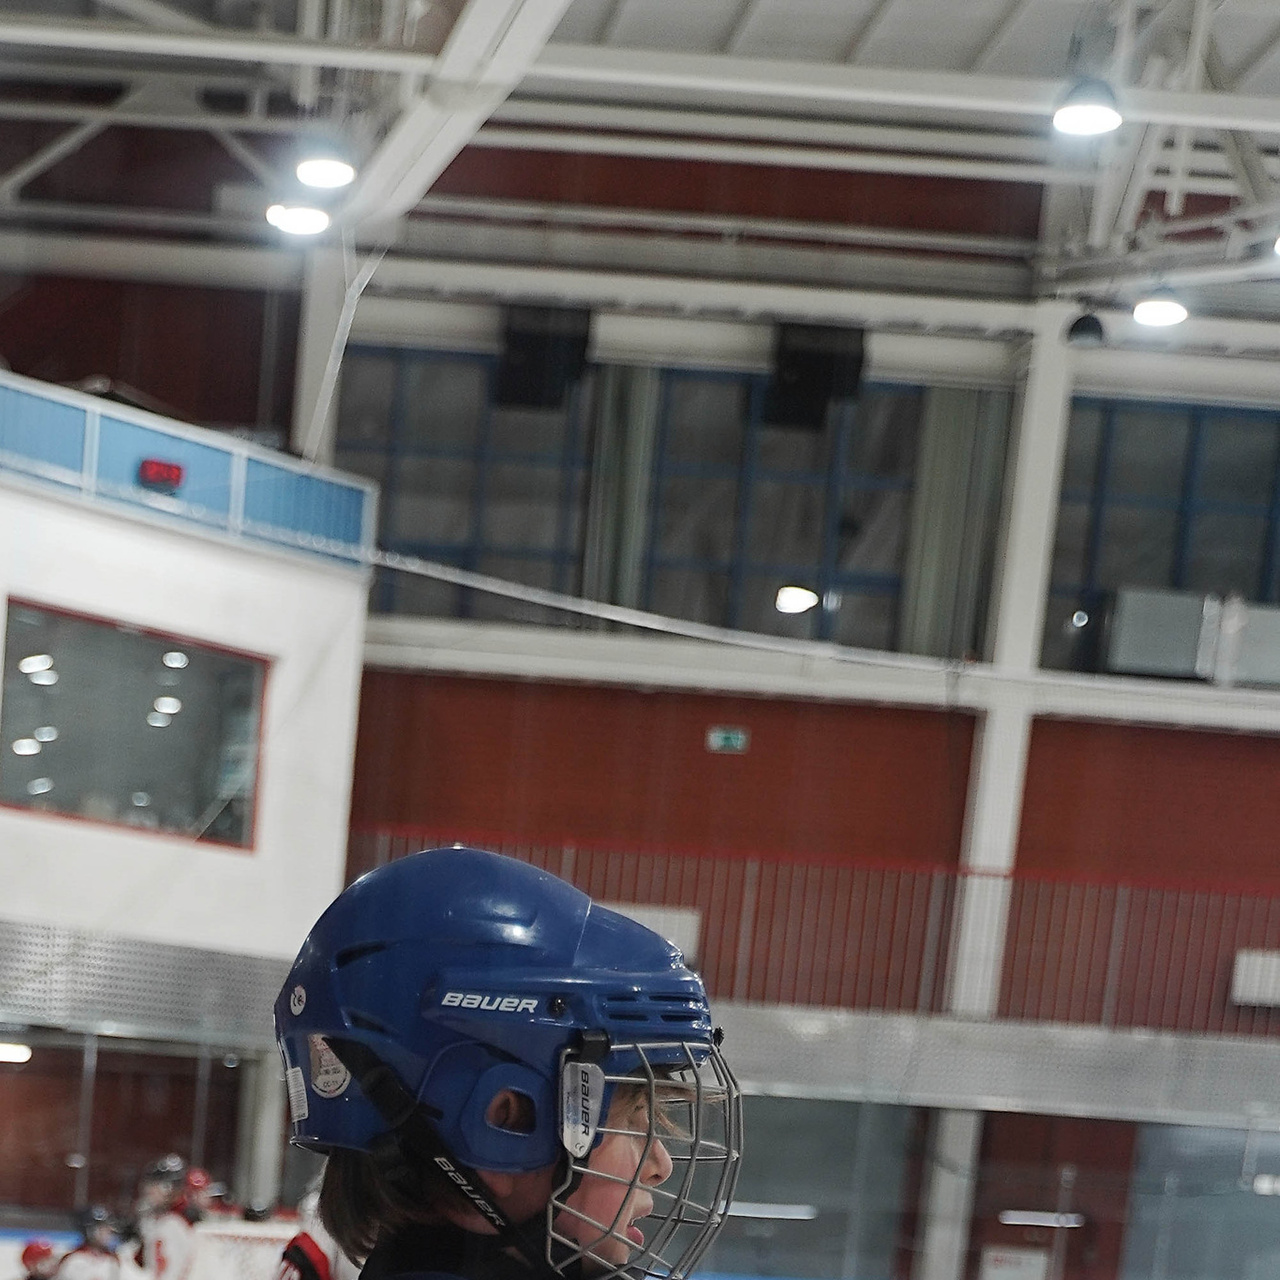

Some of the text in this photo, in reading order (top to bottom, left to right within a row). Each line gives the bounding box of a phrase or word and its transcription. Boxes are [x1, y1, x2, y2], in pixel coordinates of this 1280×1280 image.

[440, 991, 539, 1014] BAUER
[580, 1070, 590, 1137] BAUER
[434, 1157, 506, 1227] BAUER
